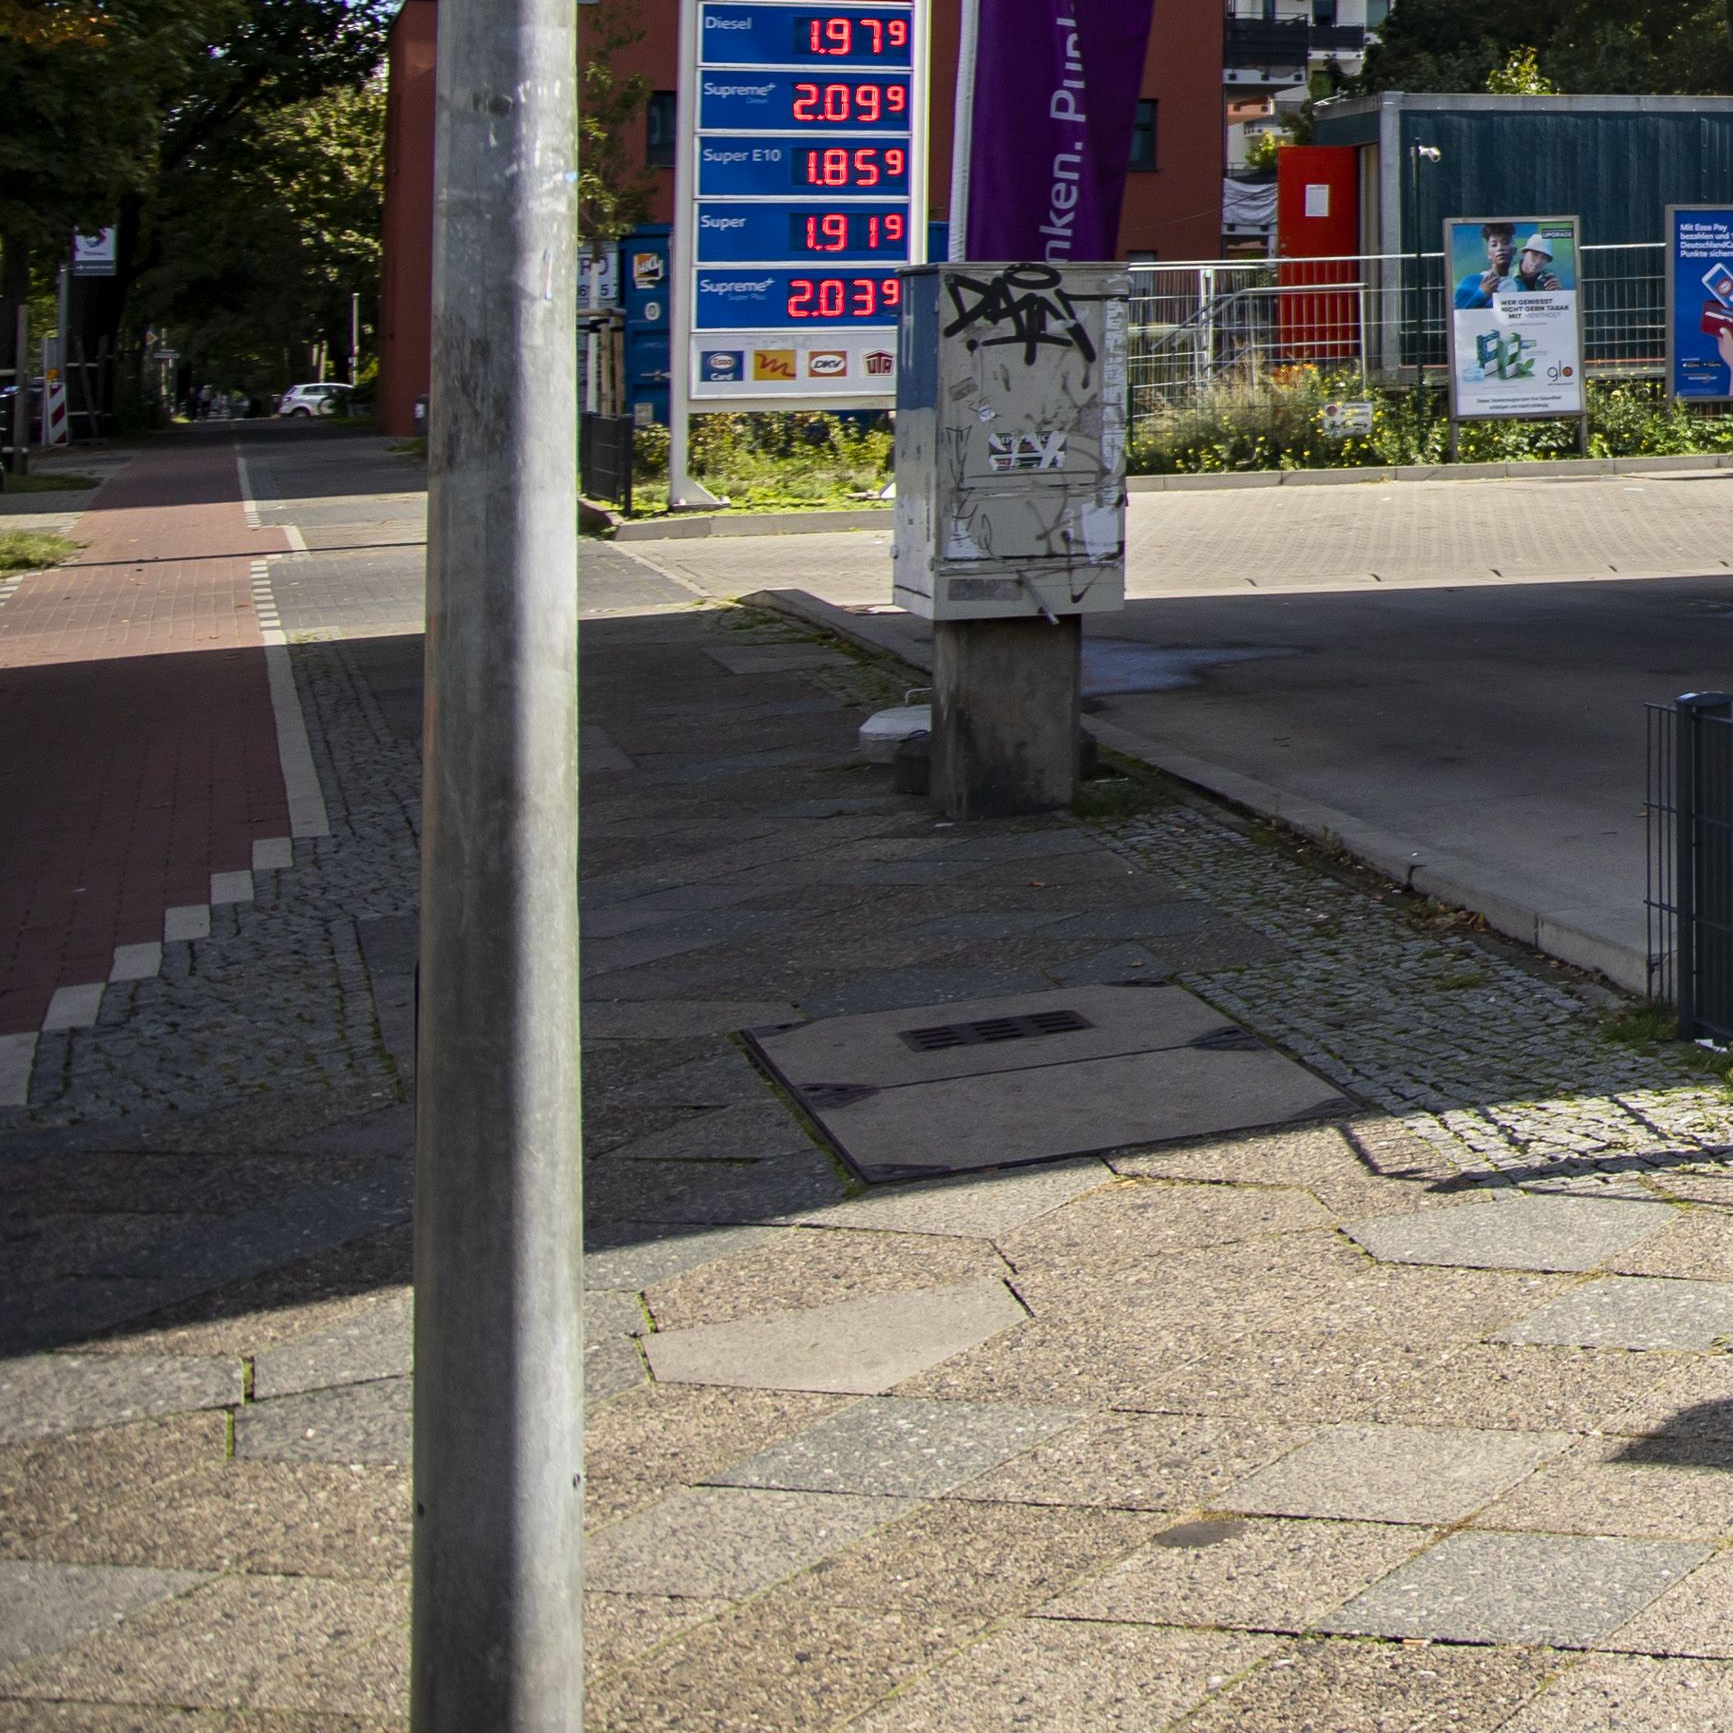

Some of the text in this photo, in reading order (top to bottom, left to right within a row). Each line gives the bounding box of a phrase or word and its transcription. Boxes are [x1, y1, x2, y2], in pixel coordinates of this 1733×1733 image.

[704, 16, 908, 56] Diesel 1.979
[792, 82, 906, 122] 2.099
[702, 148, 905, 186] Super E10 1.859
[700, 213, 904, 251] Super 1.919
[1680, 224, 1694, 232] Mit
[1713, 224, 1728, 233] Pay
[1680, 232, 1714, 241] bezahlen
[1715, 232, 1730, 241] und
[1680, 250, 1708, 258] Punkte
[813, 359, 842, 369] DKV
[1546, 359, 1574, 382] glo
[711, 372, 735, 381] Card
